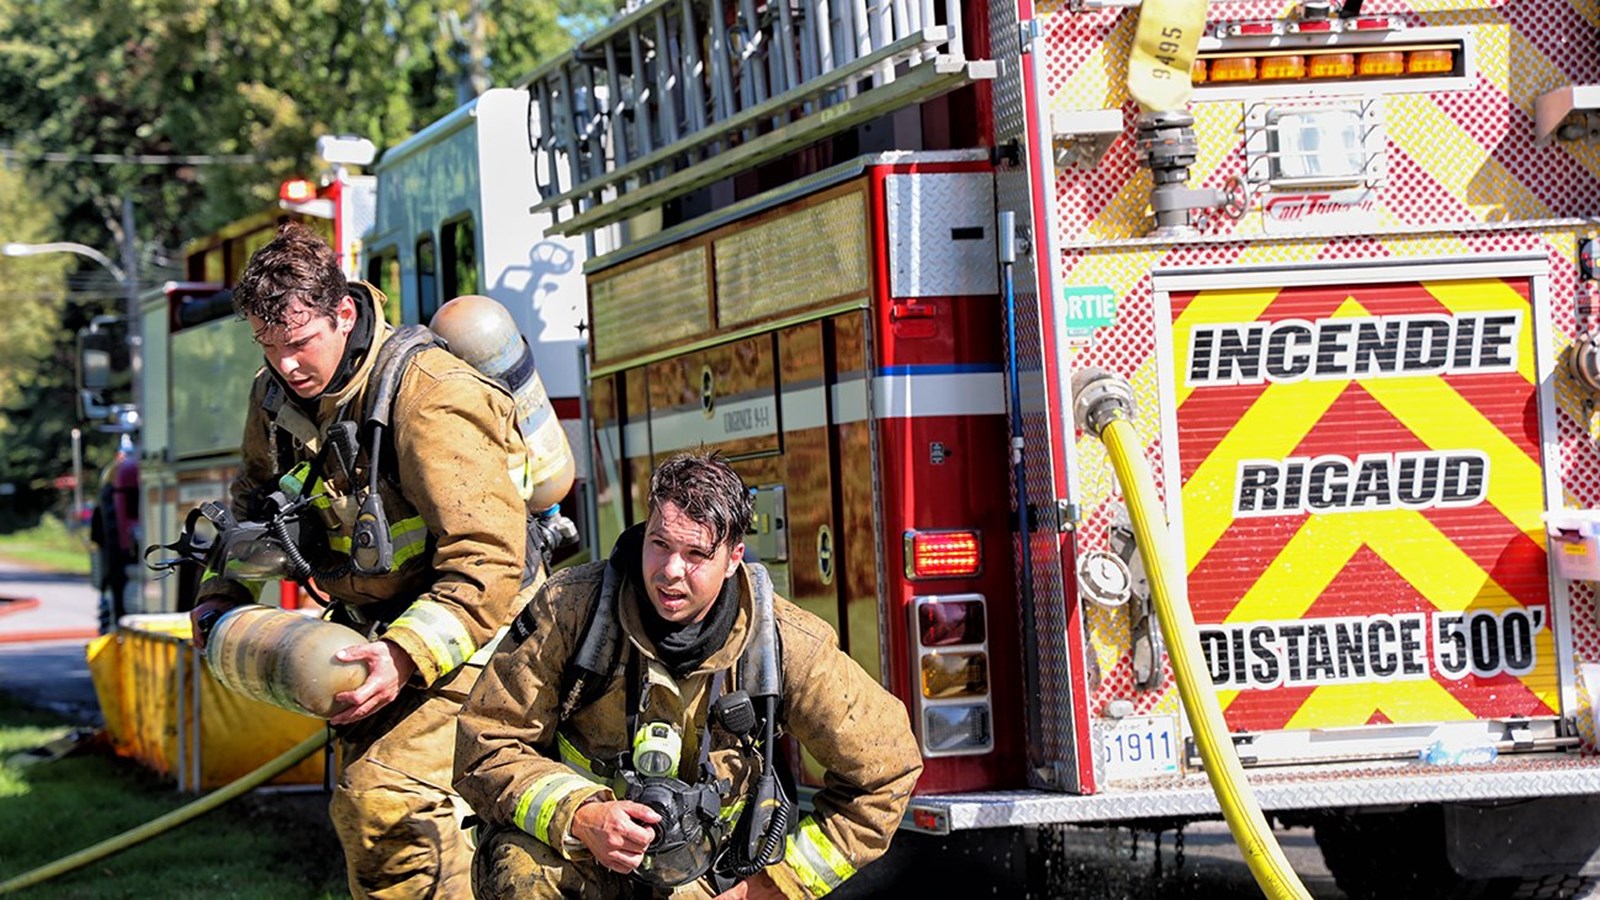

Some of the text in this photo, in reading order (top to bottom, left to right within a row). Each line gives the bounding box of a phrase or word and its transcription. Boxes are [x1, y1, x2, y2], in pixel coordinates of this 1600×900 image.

[1152, 27, 1182, 79] 9495
[1065, 295, 1115, 319] RTIE
[1189, 314, 1518, 382] INCENDIE
[1237, 455, 1486, 511] RIGAUD
[1198, 617, 1426, 685] DISTANCE
